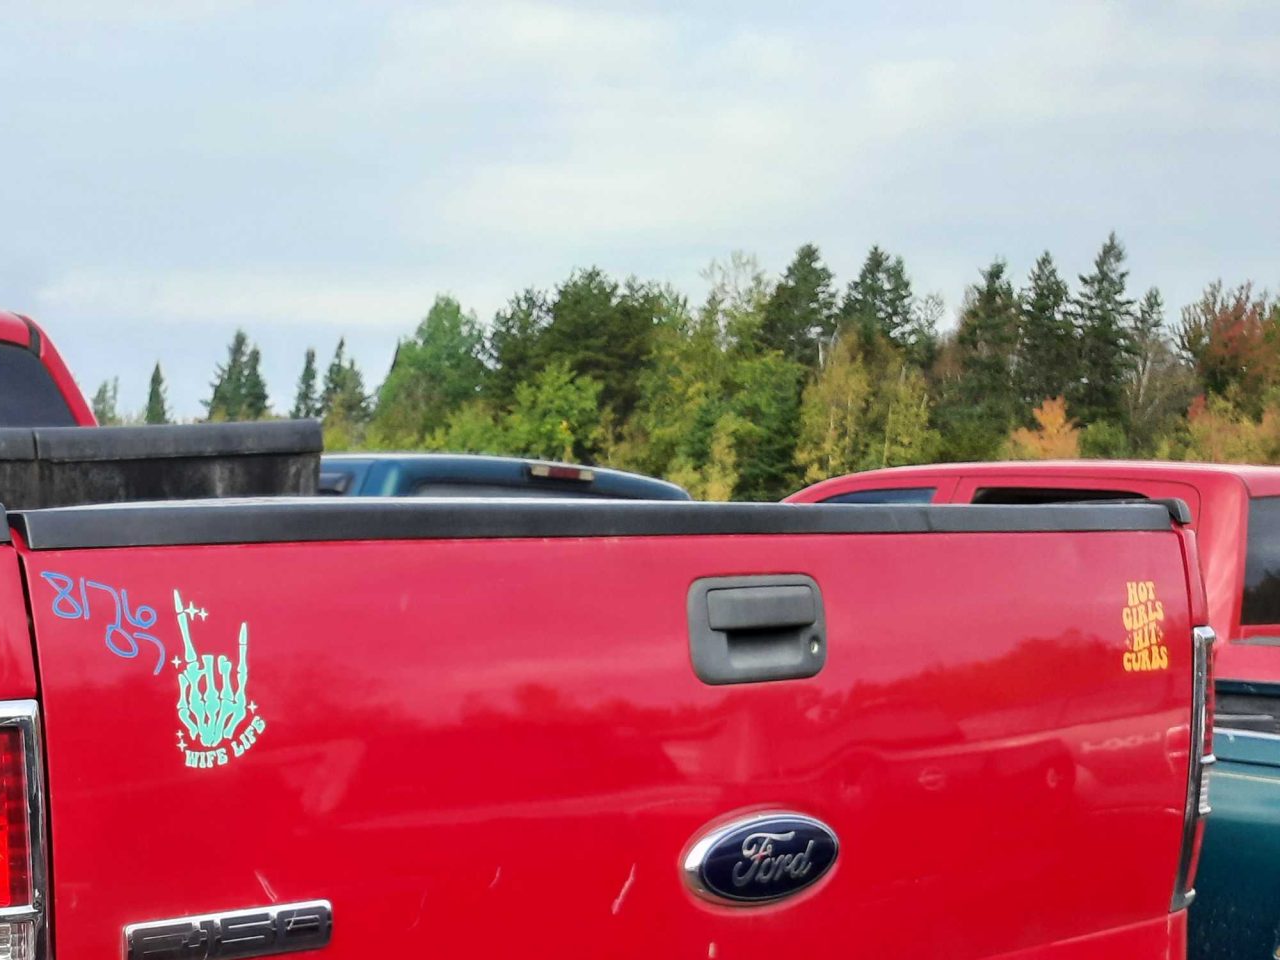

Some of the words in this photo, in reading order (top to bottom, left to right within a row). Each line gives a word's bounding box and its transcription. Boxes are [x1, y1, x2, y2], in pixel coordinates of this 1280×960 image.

[40, 571, 157, 630] 8176
[1126, 581, 1155, 606] HOT
[1122, 600, 1164, 631] GIRLS
[105, 624, 165, 675] 07
[1132, 621, 1158, 652] HIT
[1123, 645, 1168, 672] CURBS
[185, 748, 228, 768] WIFE
[231, 716, 266, 757] LIFE
[732, 831, 815, 887] Ford
